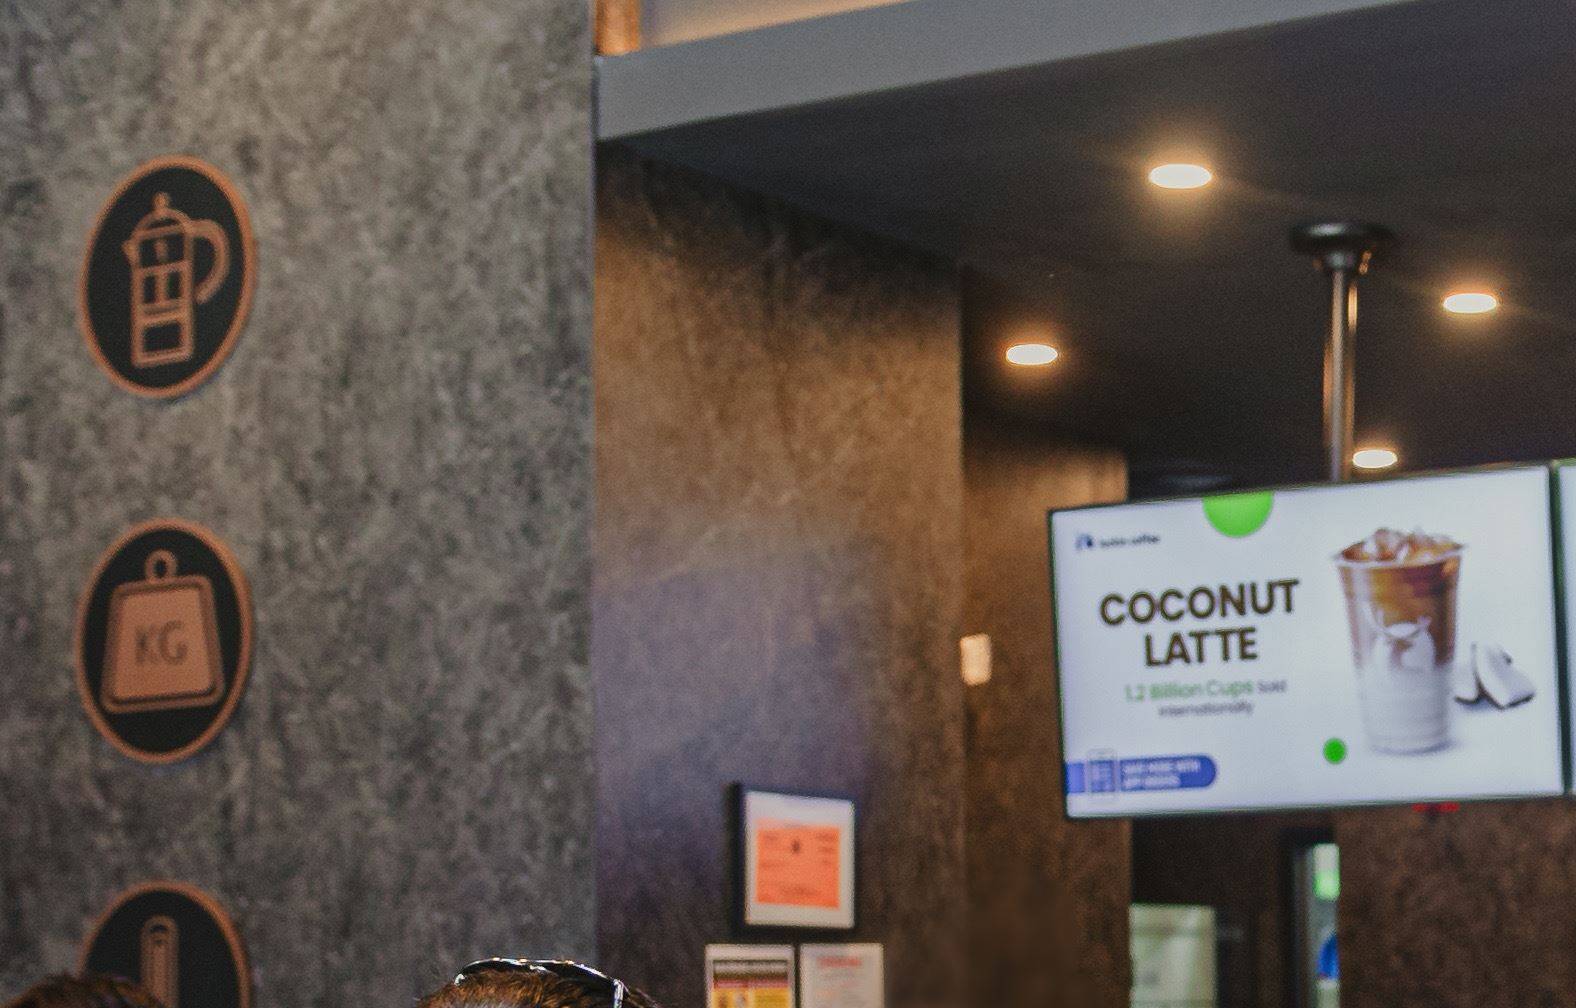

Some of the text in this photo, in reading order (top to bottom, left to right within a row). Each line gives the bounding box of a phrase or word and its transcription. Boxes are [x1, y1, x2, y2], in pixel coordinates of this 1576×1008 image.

[1100, 579, 1299, 626] COCONUT
[135, 621, 188, 666] KG
[1144, 626, 1258, 667] LATTE
[1150, 682, 1202, 699] Billion
[1206, 679, 1254, 699] Cups
